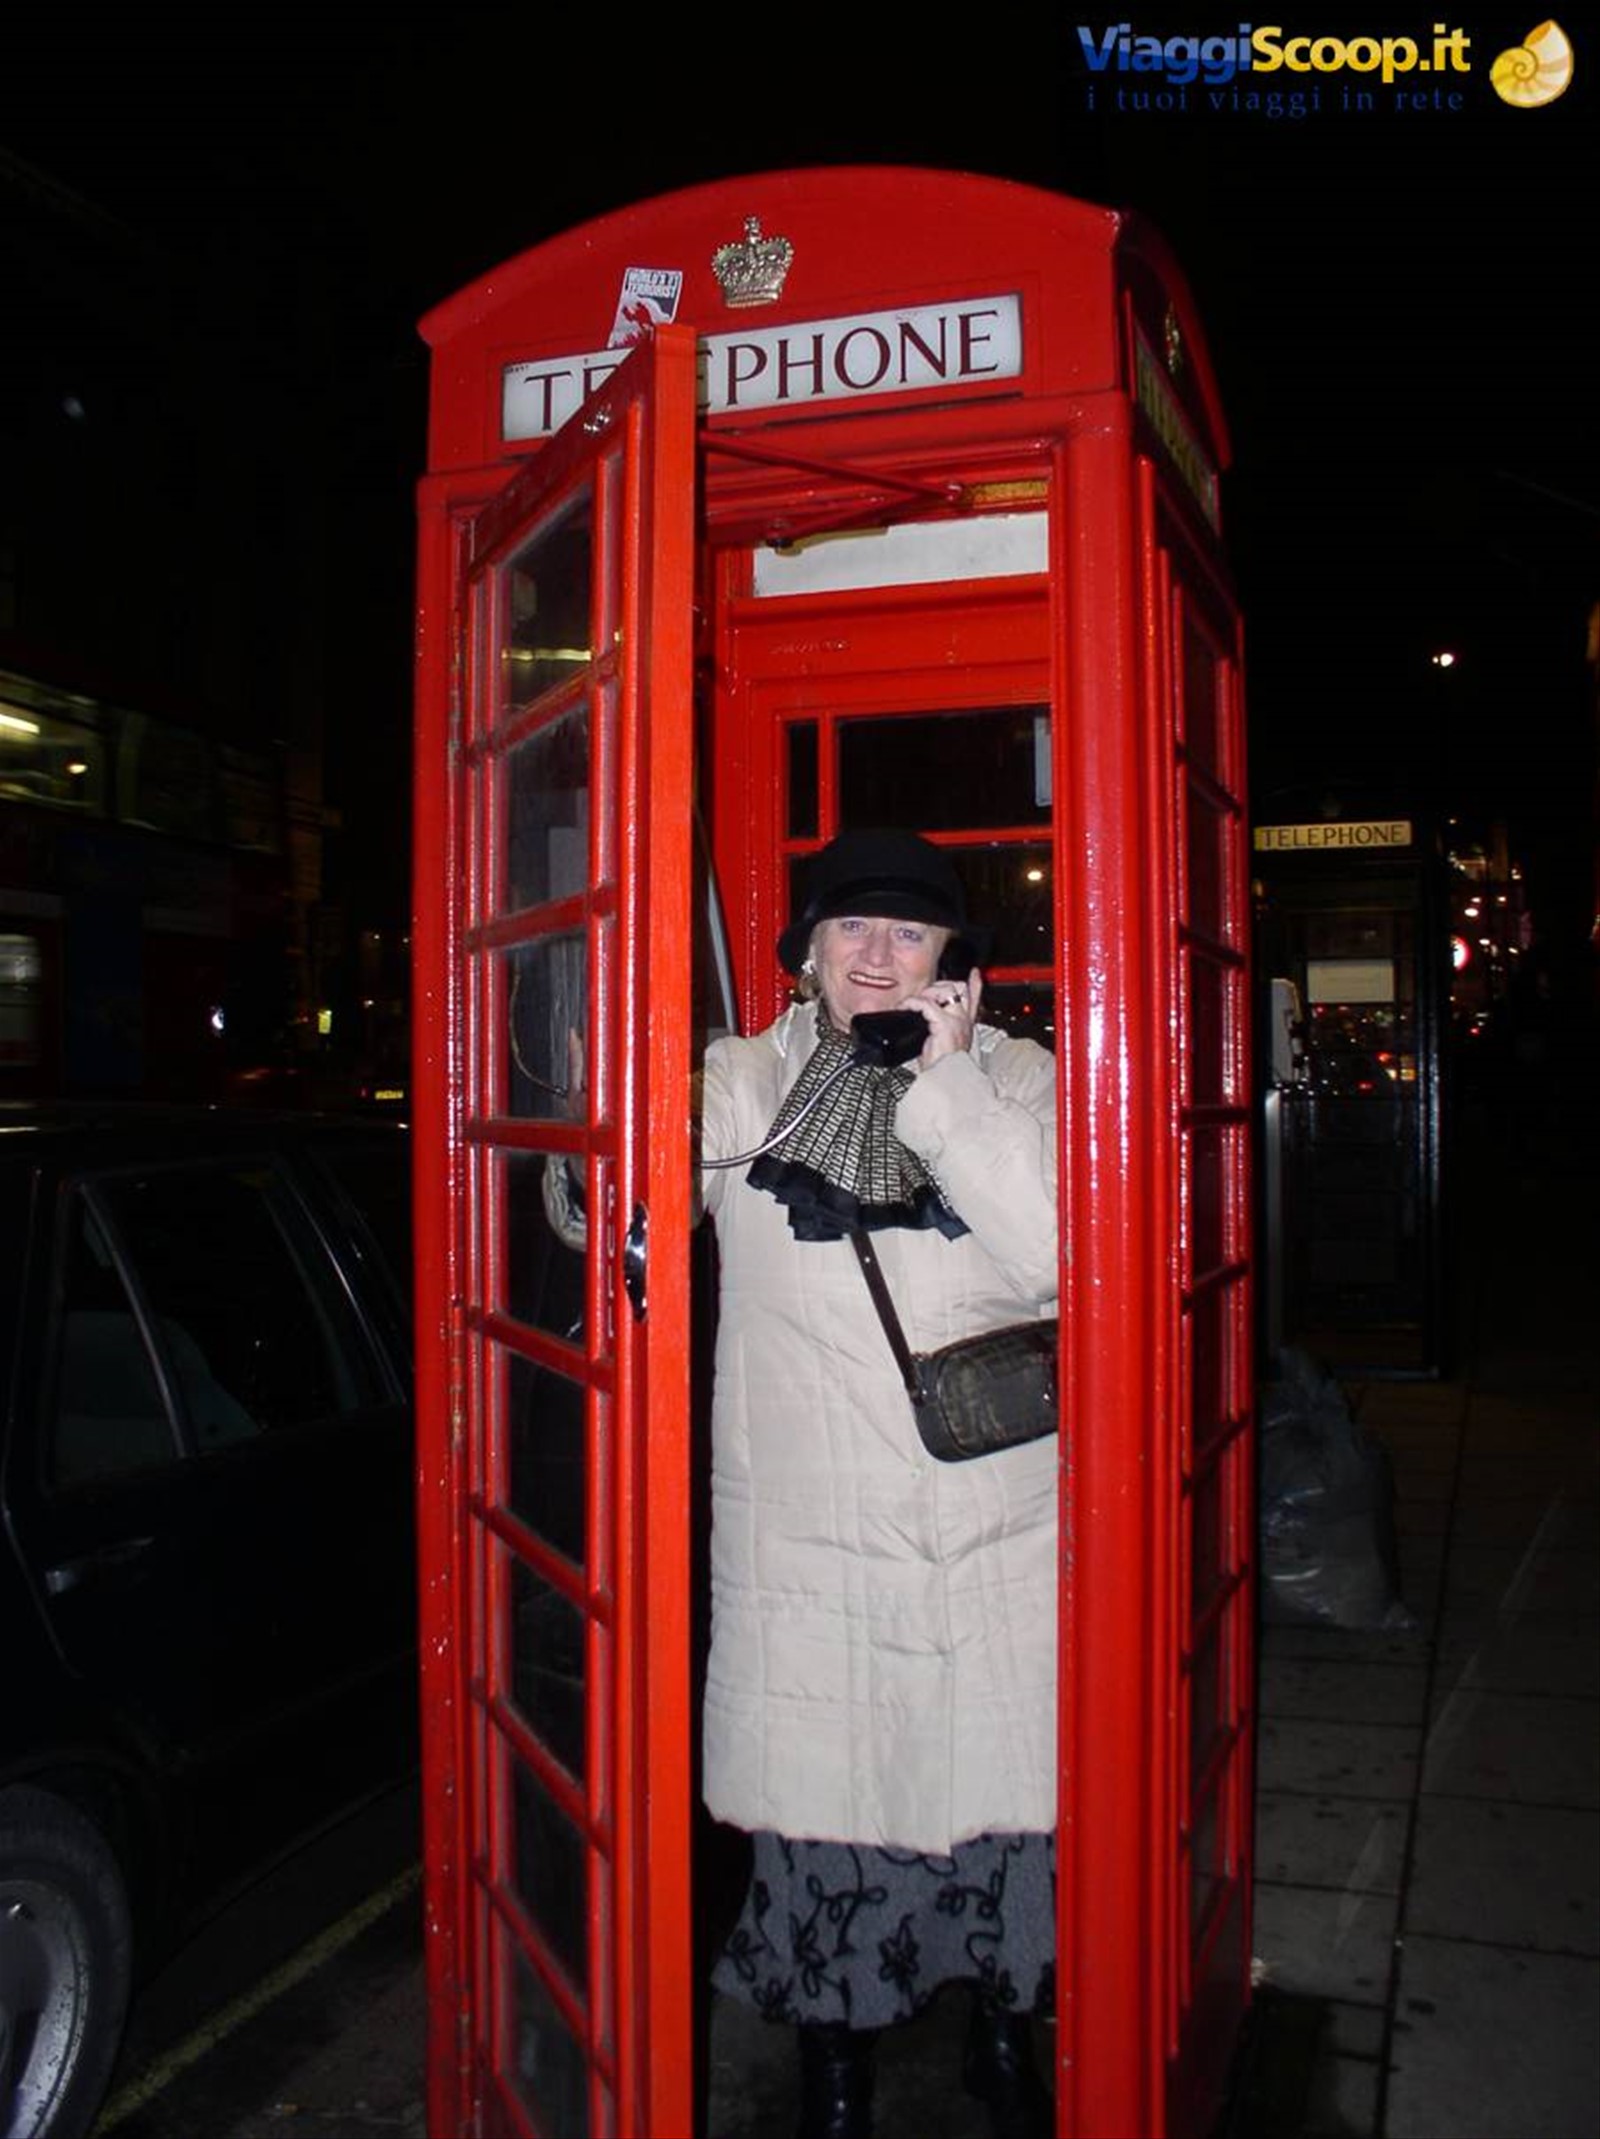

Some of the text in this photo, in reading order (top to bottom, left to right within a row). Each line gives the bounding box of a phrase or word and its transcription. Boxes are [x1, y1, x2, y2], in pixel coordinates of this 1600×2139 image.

[524, 310, 1000, 431] TPHONE
[1260, 824, 1405, 847] TELEPHONE
[606, 1184, 616, 1338] PULL
